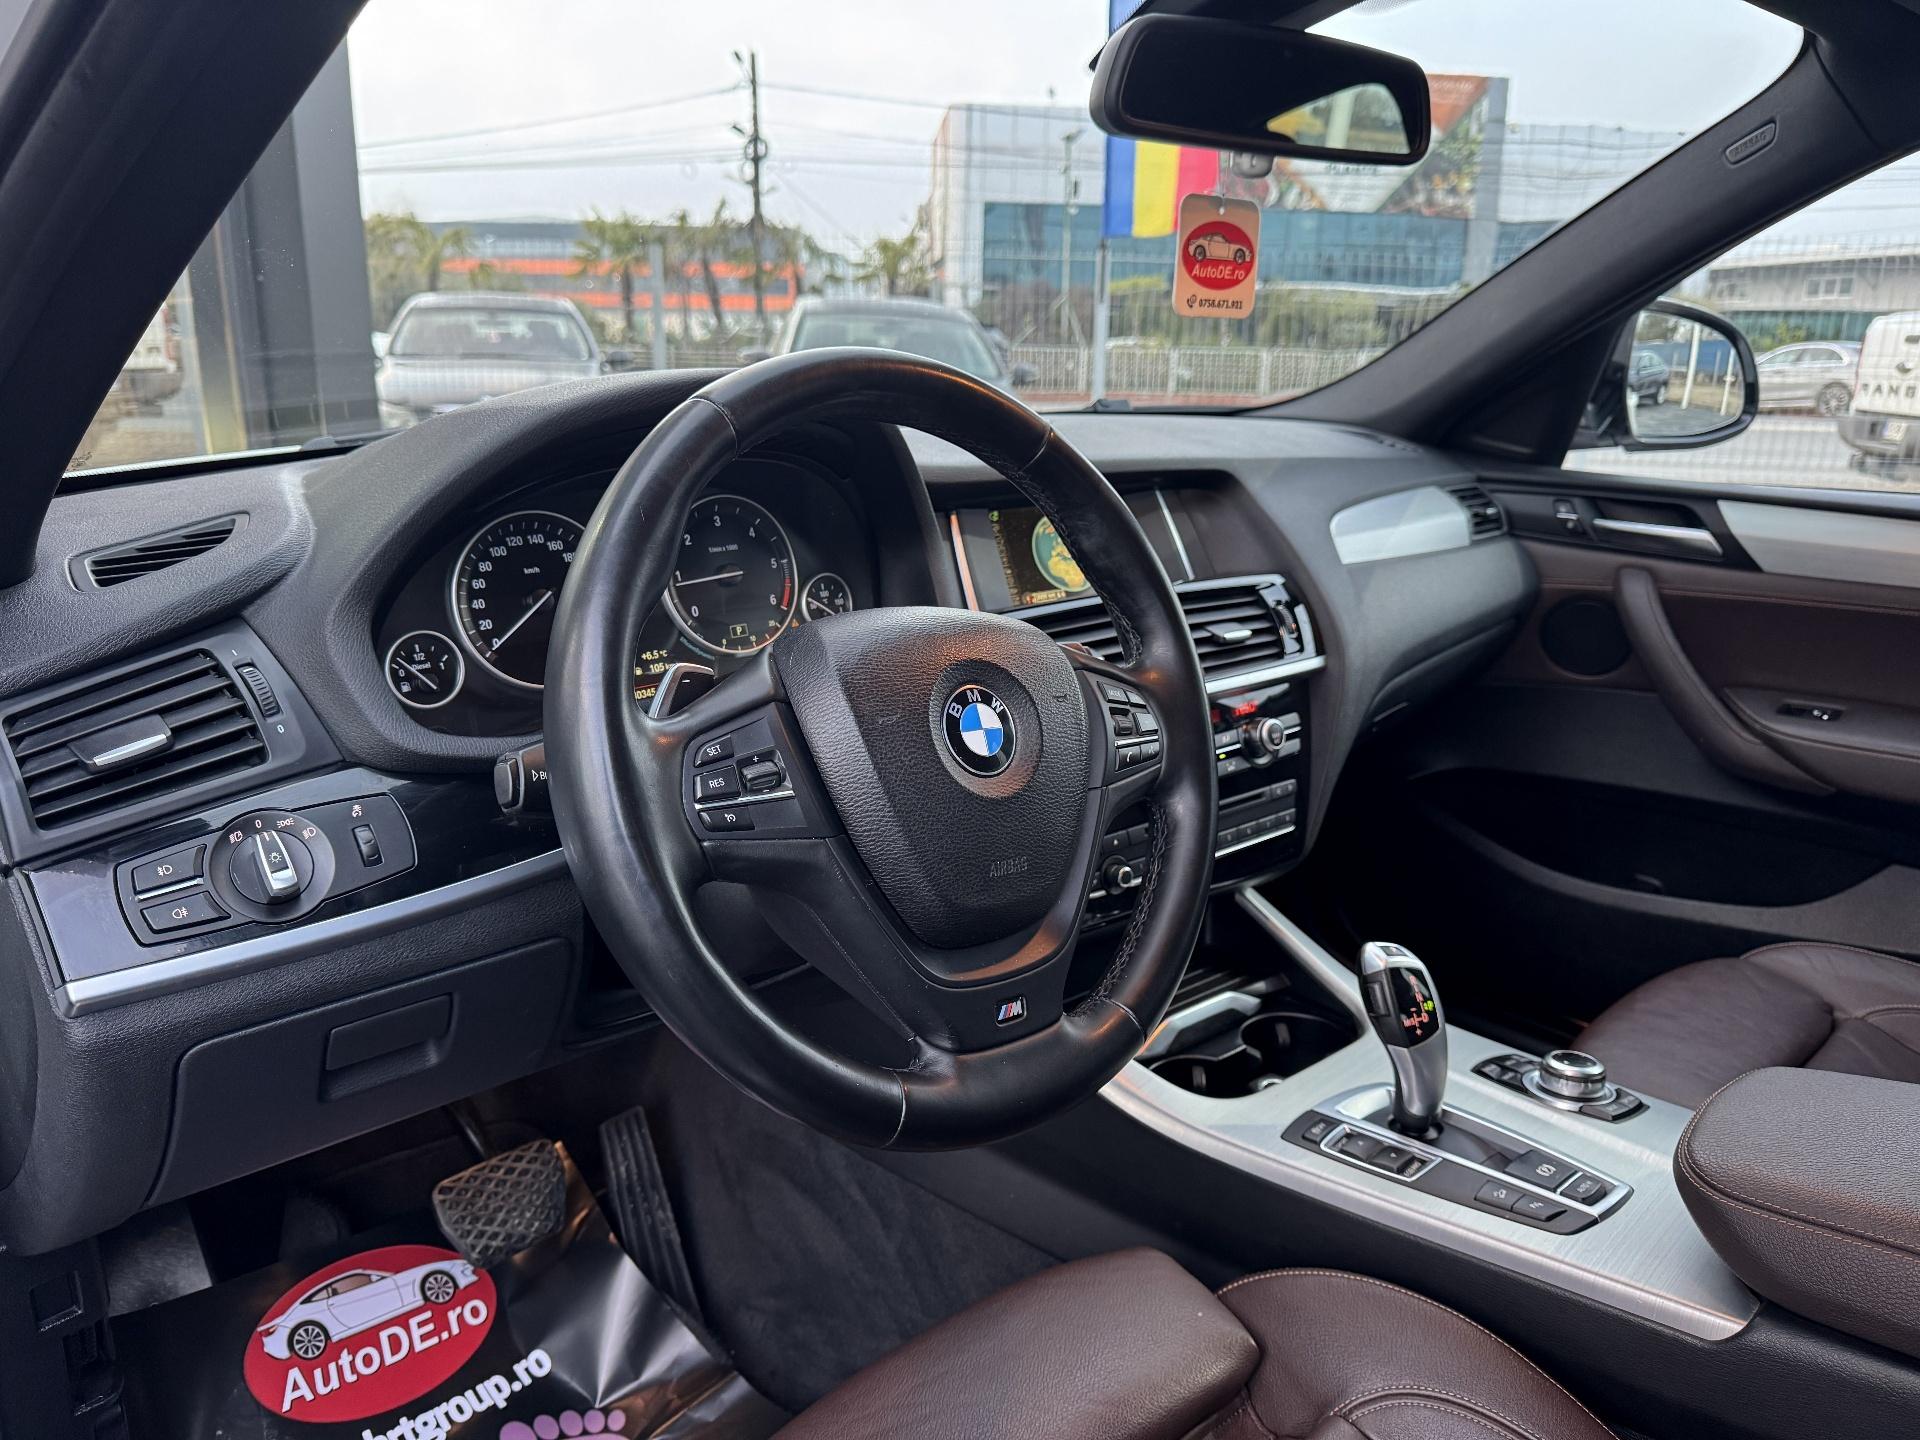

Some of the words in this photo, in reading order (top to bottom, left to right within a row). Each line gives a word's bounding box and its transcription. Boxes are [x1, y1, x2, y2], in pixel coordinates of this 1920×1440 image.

[1191, 263, 1245, 280] AutoDE.ro
[714, 515, 721, 527] 3
[749, 527, 756, 539] 4
[505, 536, 524, 547] 120
[527, 534, 545, 545] 140
[546, 540, 564, 551] 160
[683, 534, 692, 546] 2
[489, 545, 507, 558] 100
[562, 552, 575, 563] 18
[478, 561, 493, 572] 80
[770, 558, 778, 569] 5
[523, 566, 541, 575] km/h
[675, 570, 682, 582] 1
[471, 578, 486, 590] 60
[471, 598, 486, 610] 40
[769, 594, 777, 606] 6
[691, 605, 699, 618] 0
[478, 619, 493, 631] 20
[736, 626, 743, 636] P
[492, 638, 501, 649] 0
[413, 652, 426, 661] 1/2
[641, 650, 659, 661] +6.5
[411, 661, 432, 671] Diesel
[439, 662, 445, 670] 1
[649, 662, 665, 673] 105
[398, 669, 405, 677] 0
[634, 687, 656, 700] 0345
[948, 689, 1004, 719] BMW
[706, 744, 722, 757] SET
[708, 777, 725, 789] RES
[255, 819, 262, 829] 0
[990, 855, 1028, 878] AIRBAG
[281, 1299, 488, 1414] AutoDE.ro
